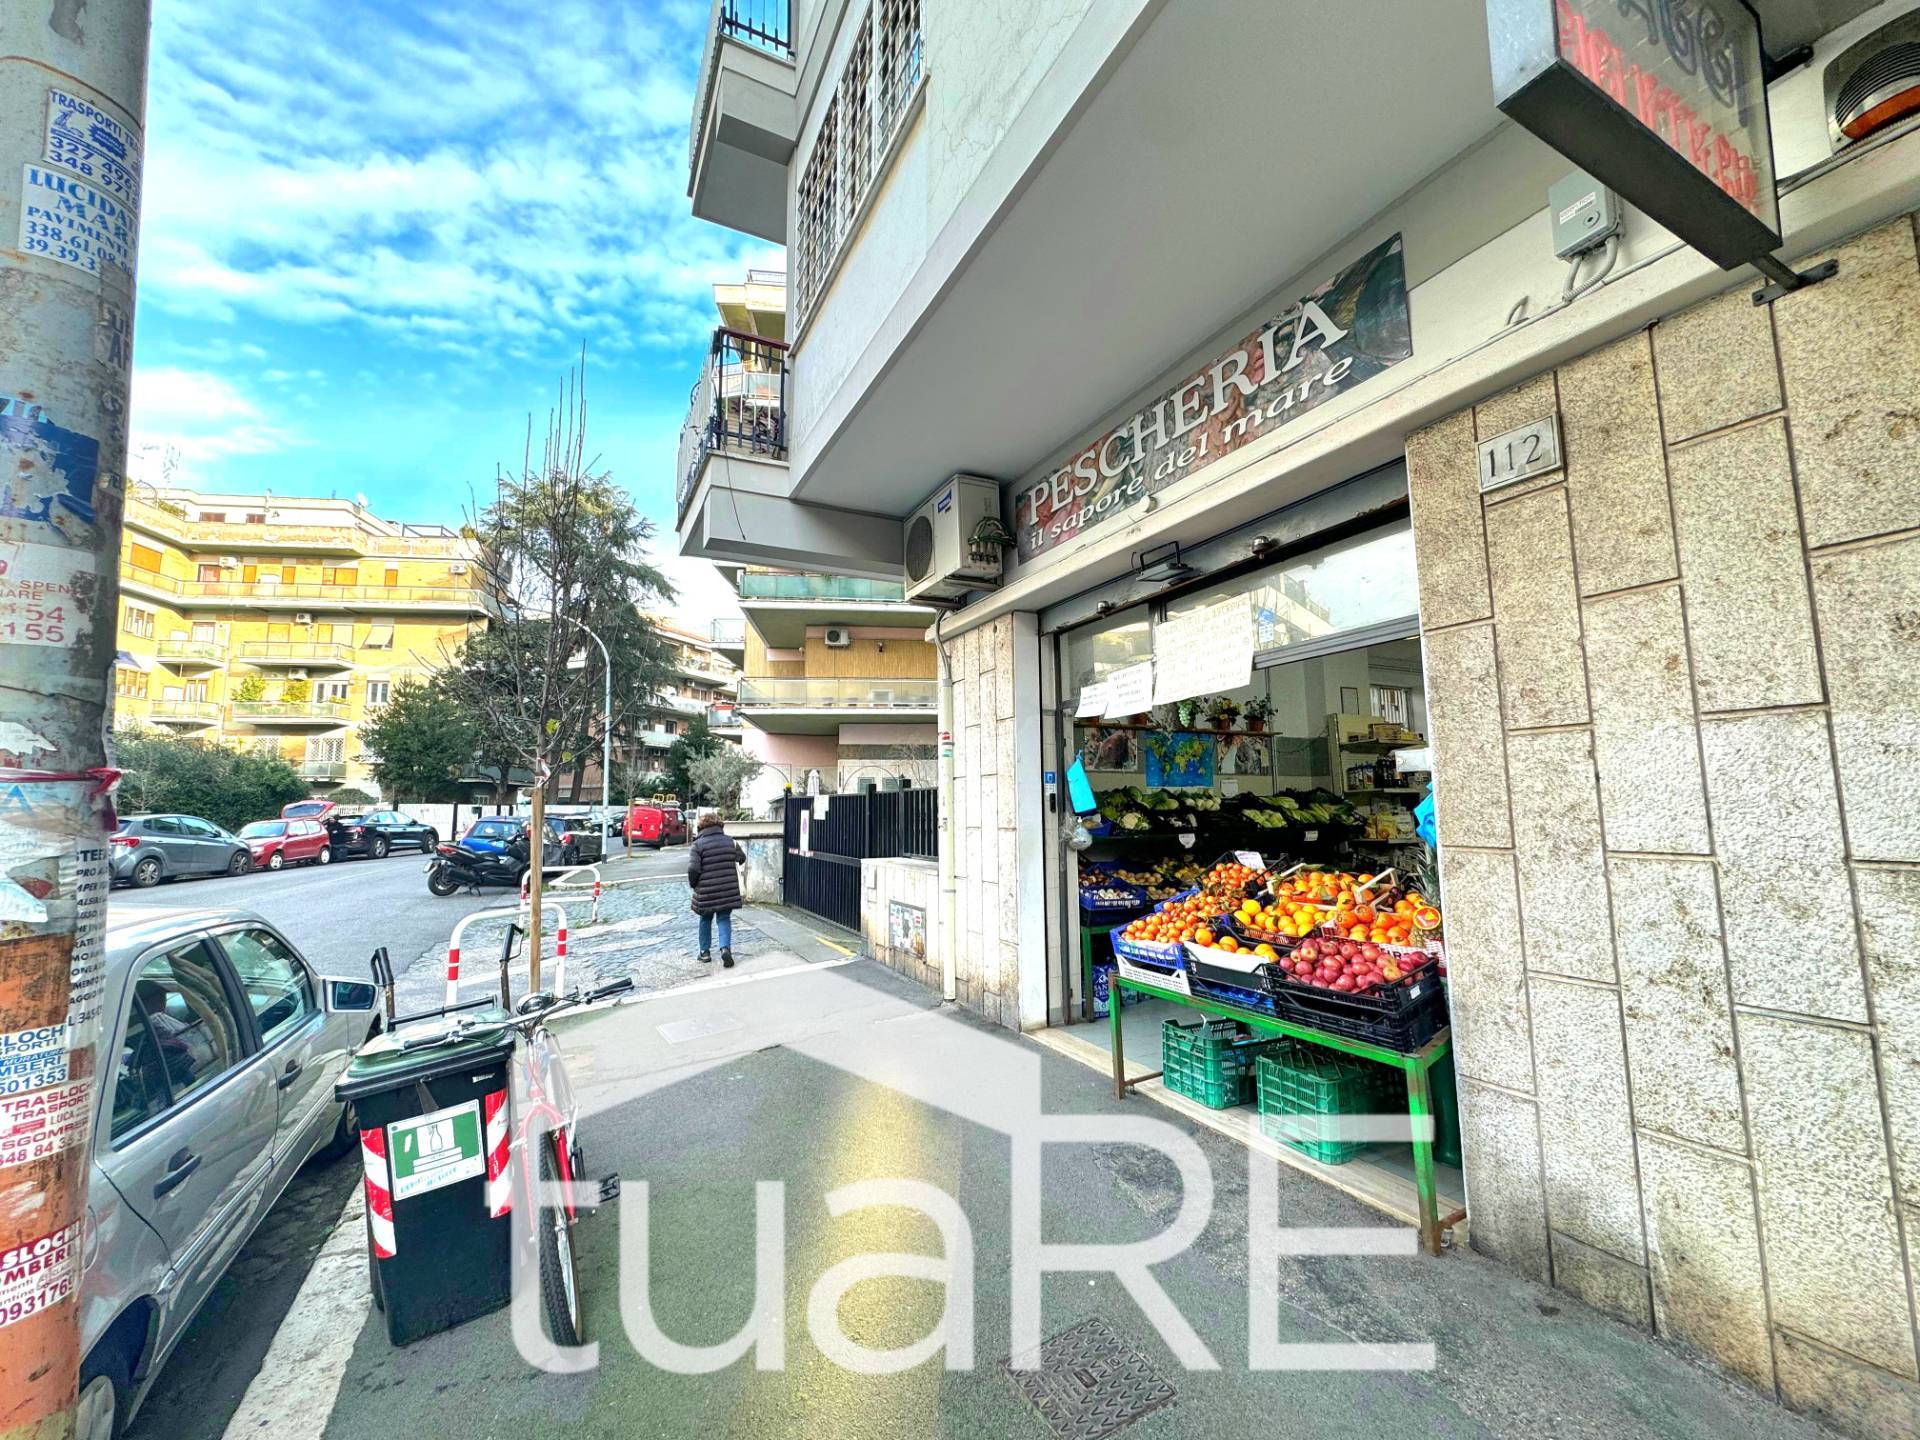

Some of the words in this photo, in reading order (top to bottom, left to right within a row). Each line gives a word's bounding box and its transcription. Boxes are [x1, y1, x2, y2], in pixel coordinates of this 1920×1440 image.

[50, 90, 121, 138] TRASPORTI
[49, 150, 93, 177] 348
[50, 135, 94, 161] 327
[27, 205, 128, 259] PAVIMENTI
[1028, 301, 1348, 525] PESCHERIA
[1030, 530, 1044, 551] il
[1051, 475, 1146, 538] sapore
[1154, 434, 1208, 479] del
[1221, 356, 1354, 443] mare
[1487, 433, 1543, 478] 112
